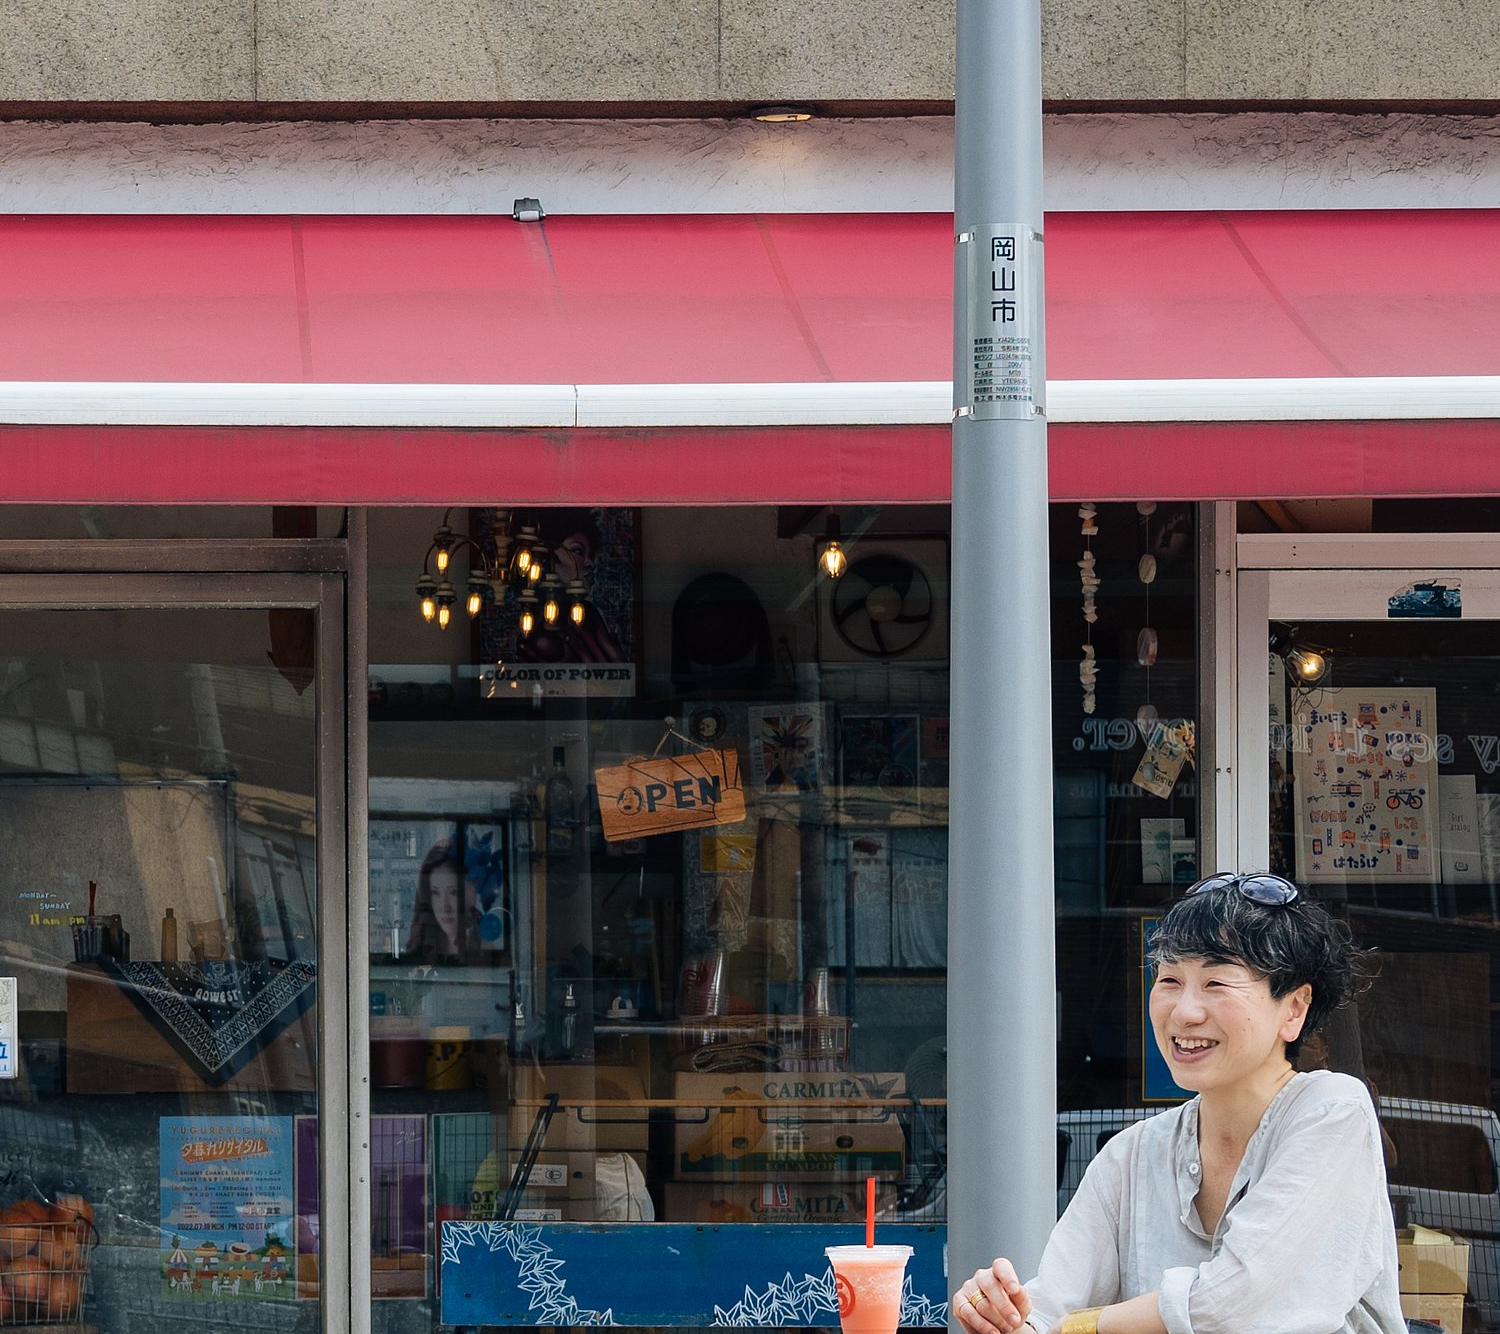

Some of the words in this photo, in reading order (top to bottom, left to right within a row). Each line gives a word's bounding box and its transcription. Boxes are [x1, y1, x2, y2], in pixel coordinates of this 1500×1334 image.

[991, 236, 1016, 324] 岡山市
[485, 669, 541, 681] COLOR
[543, 669, 567, 681] OF
[569, 668, 631, 681] POWER
[617, 774, 722, 816] OPEN
[1333, 854, 1379, 869] はたらけ
[39, 902, 71, 910] SUNDAY
[763, 1079, 863, 1099] CARMITA
[766, 1152, 837, 1162] BANANAS
